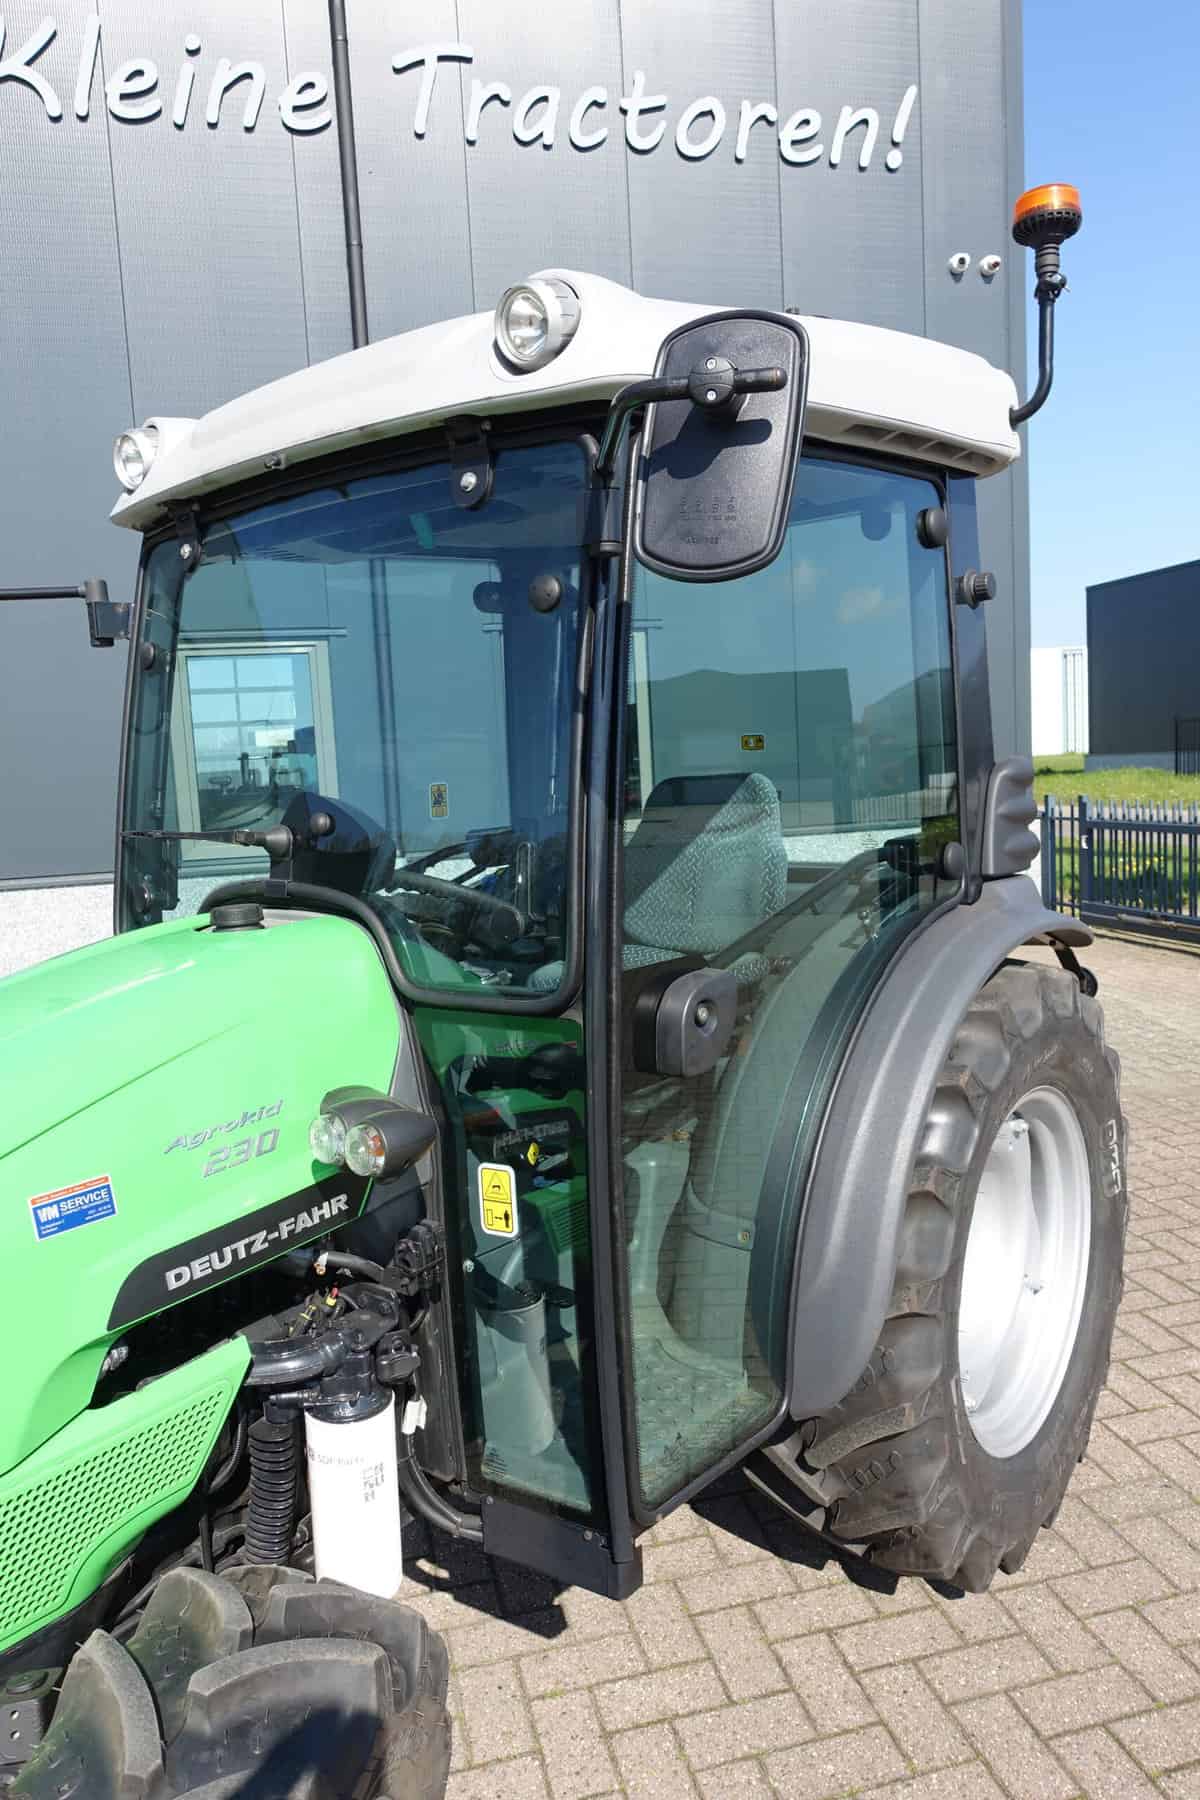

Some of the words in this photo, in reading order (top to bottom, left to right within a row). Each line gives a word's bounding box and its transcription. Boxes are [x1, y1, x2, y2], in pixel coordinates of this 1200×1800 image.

[0, 14, 332, 131] Kleine
[391, 41, 918, 171] Tractoren!
[163, 1099, 284, 1154] Agrokid
[203, 1128, 281, 1178] 230
[59, 1188, 109, 1212] SERVICE
[164, 1193, 350, 1291] DEUTZ-FAHR
